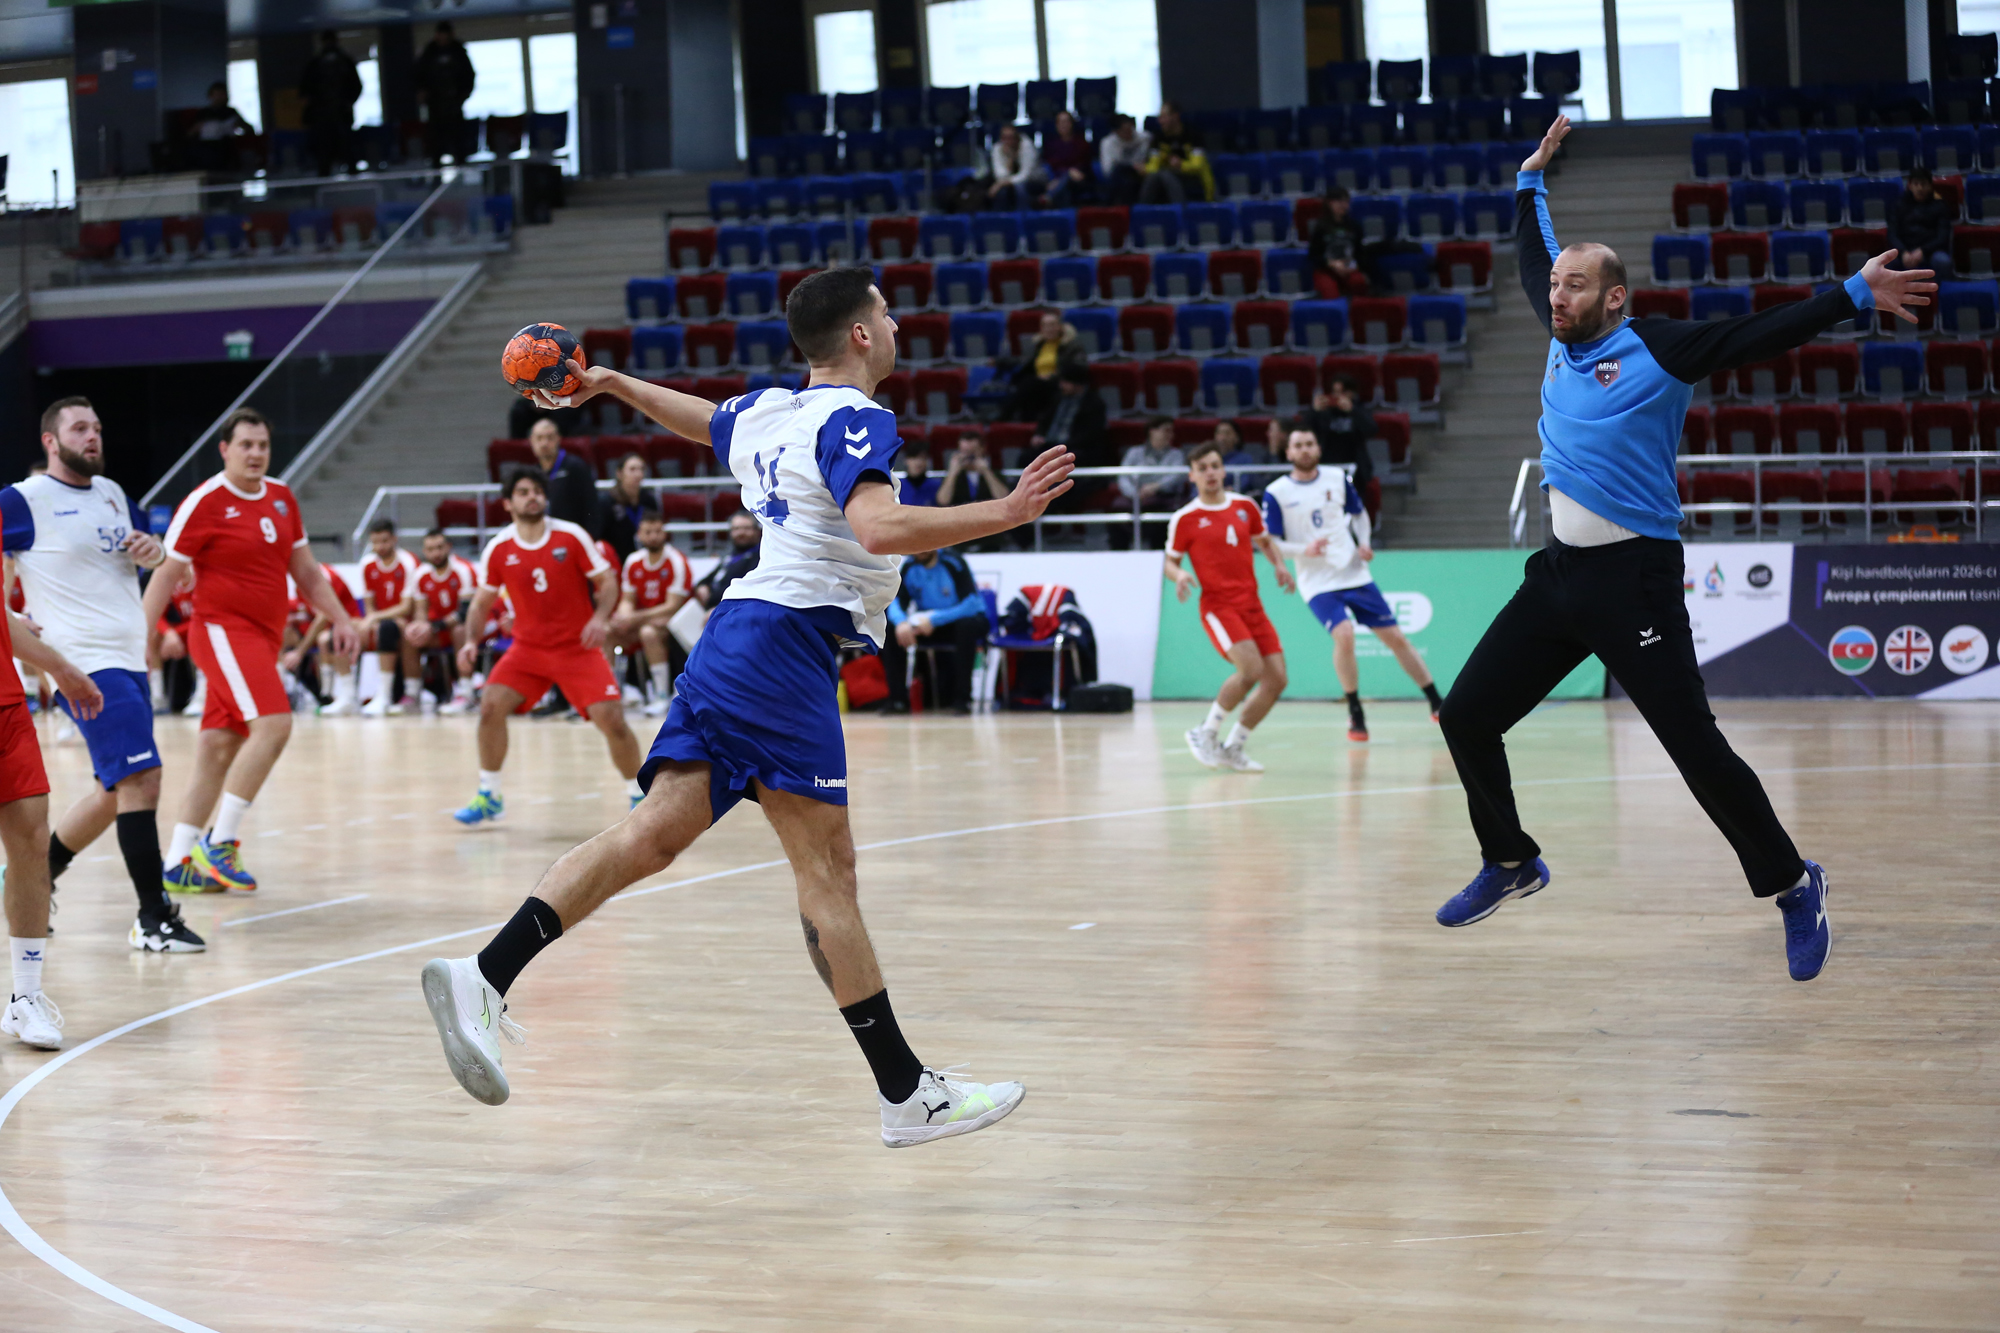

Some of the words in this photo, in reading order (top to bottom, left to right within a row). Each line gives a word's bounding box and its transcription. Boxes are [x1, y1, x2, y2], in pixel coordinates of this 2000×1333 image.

[1598, 362, 1619, 371] MHA
[1312, 509, 1323, 528] 6
[259, 517, 278, 544] 9
[1226, 524, 1239, 547] 4
[532, 567, 548, 593] 3
[1824, 588, 1871, 605] Avropa
[1640, 635, 1661, 647] erima
[814, 775, 847, 788] humme
